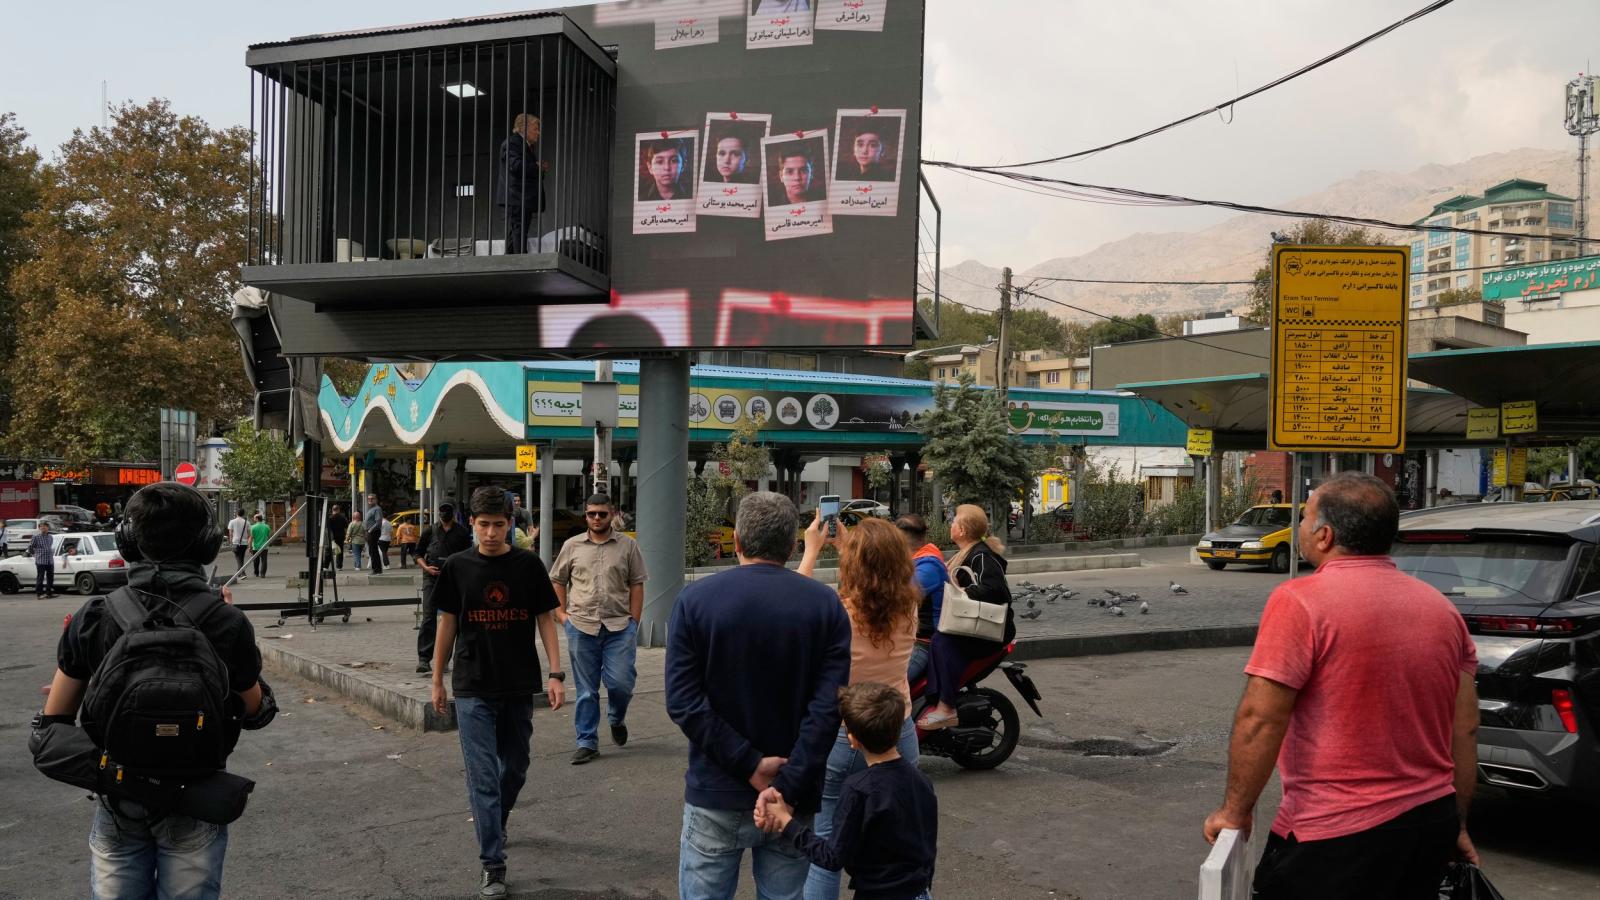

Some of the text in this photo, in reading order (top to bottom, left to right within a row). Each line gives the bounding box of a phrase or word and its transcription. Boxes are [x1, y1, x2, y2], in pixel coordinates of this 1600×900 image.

[722, 187, 738, 196] شهید
[856, 184, 873, 194] شهید
[656, 203, 671, 213] شهید
[790, 206, 806, 216] شهید
[1483, 272, 1503, 284] تهران
[1505, 269, 1538, 282] شهرداری
